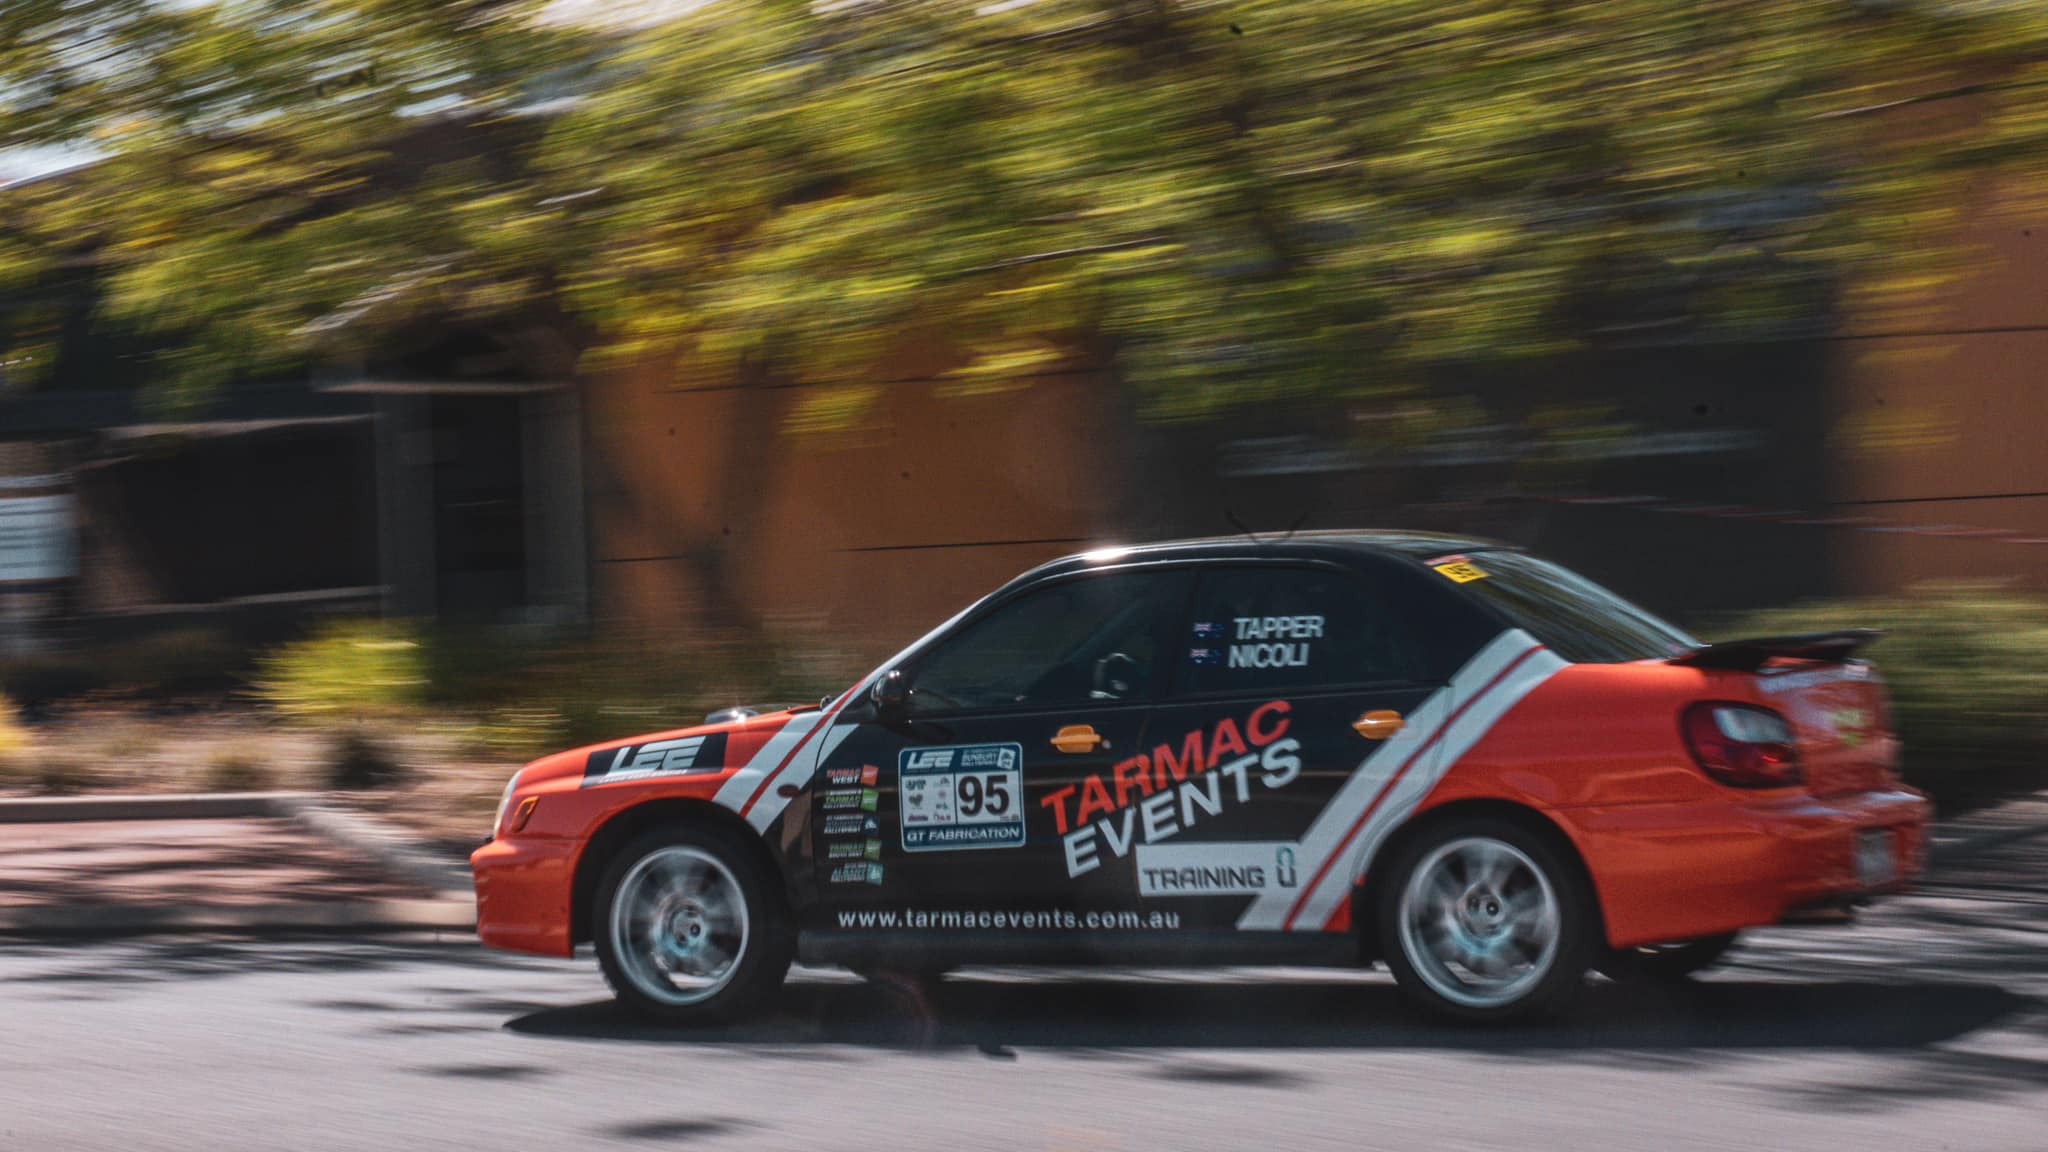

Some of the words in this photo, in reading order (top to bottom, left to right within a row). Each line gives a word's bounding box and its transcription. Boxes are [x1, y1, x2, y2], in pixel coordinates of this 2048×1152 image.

[1233, 615, 1325, 640] TAPPER
[1228, 643, 1310, 668] NICOLI
[605, 736, 706, 777] LEE
[906, 751, 955, 769] LEE
[1040, 700, 1292, 834] TARMAC
[827, 768, 860, 778] TARMAC
[832, 775, 860, 784] WEST
[826, 795, 860, 803] TARMAC
[958, 774, 1010, 817] 95
[1063, 738, 1301, 879] EVENTS
[907, 832, 927, 842] GT
[929, 827, 1020, 841] FABRICATION
[1143, 866, 1266, 890] TRAINING
[838, 907, 1181, 929] www.tarmacevents.com.au
